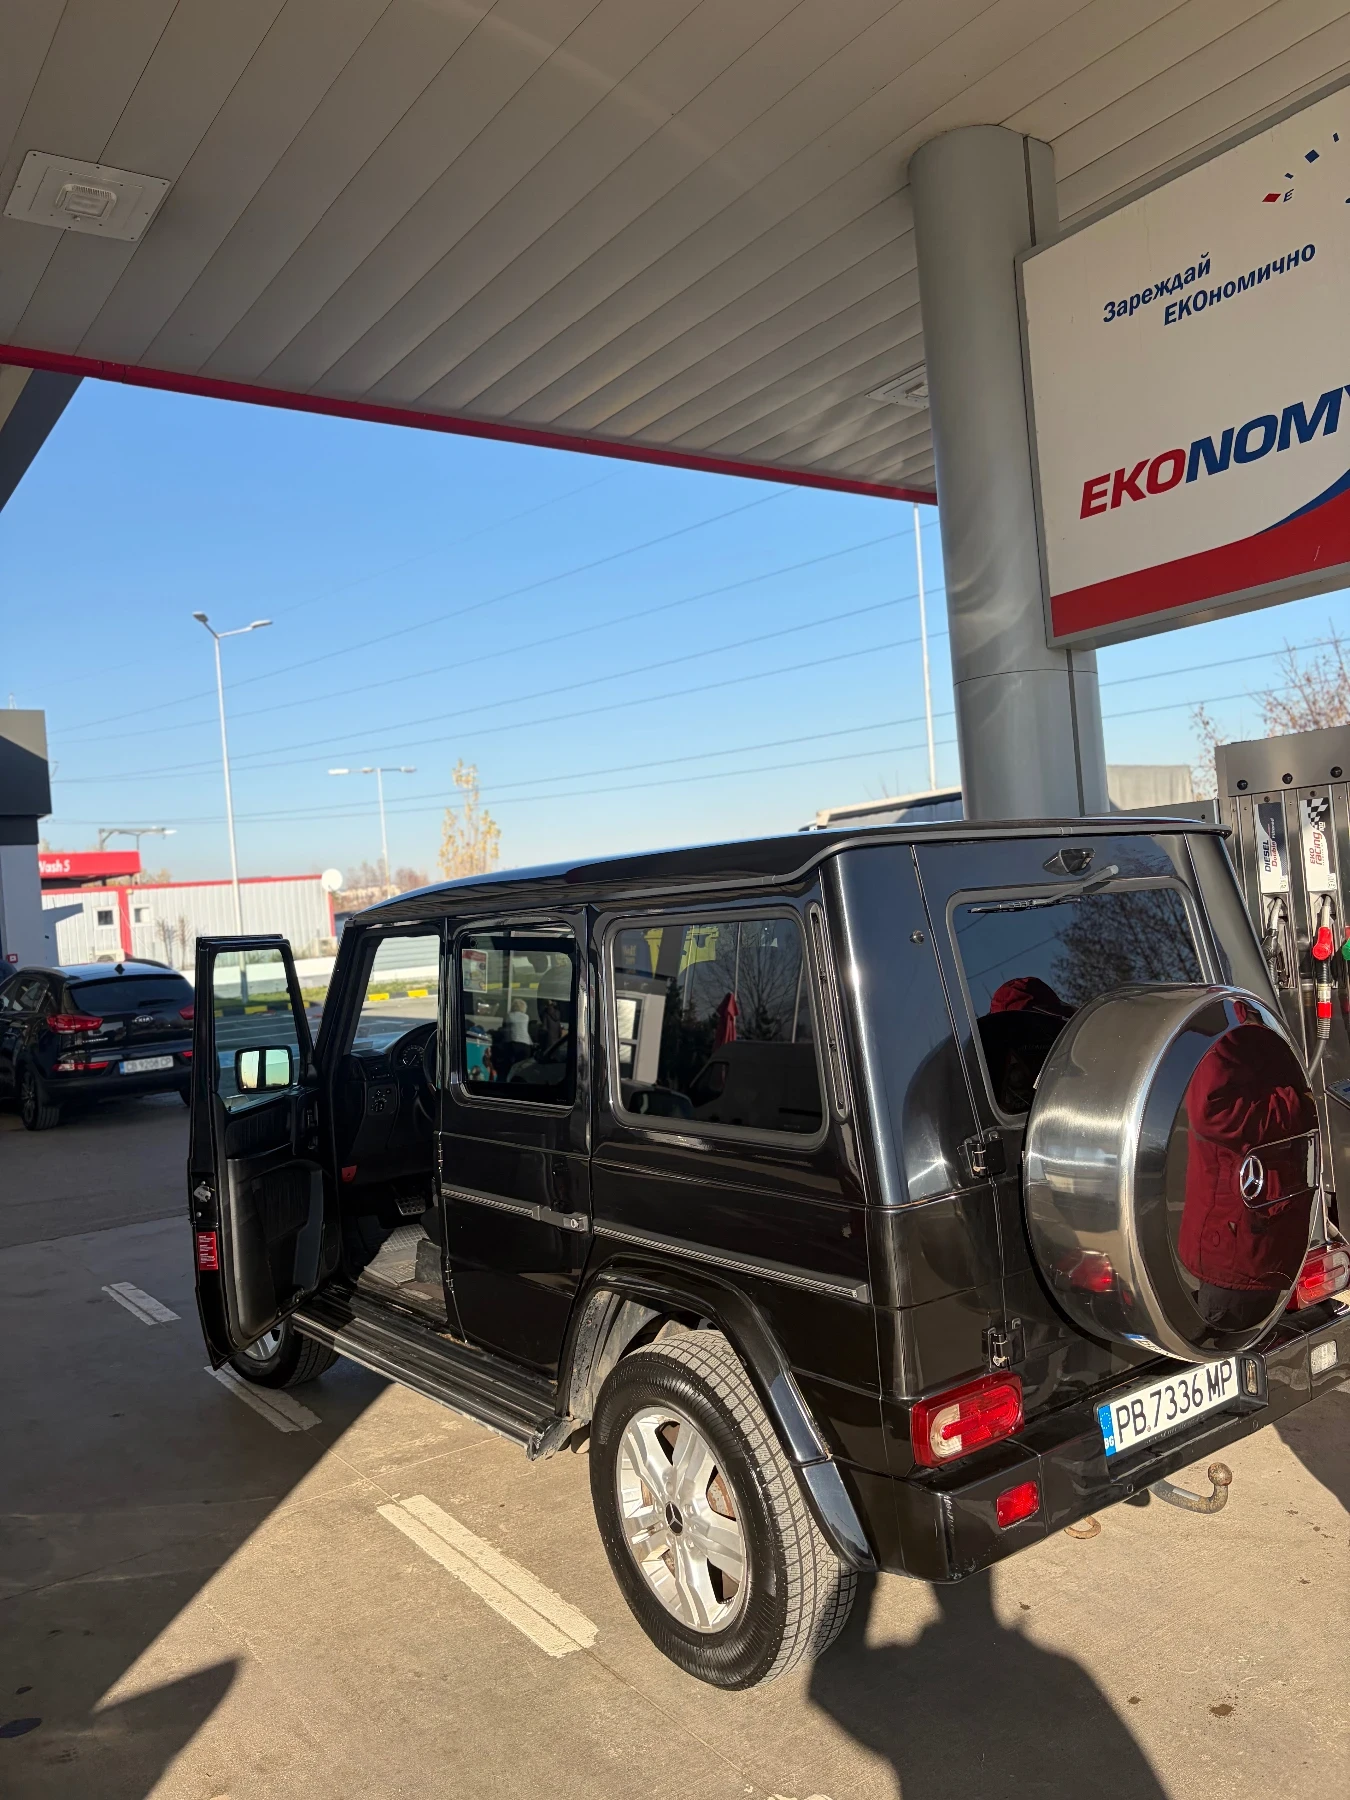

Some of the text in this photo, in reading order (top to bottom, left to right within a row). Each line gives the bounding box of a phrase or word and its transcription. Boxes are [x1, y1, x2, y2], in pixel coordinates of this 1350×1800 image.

[1283, 188, 1294, 203] E
[1103, 252, 1211, 323] Зареждай
[1164, 244, 1316, 326] ЕКОномично
[1080, 384, 1350, 520] EKONOM
[1263, 840, 1271, 872] DIESEL
[1313, 831, 1323, 866] racing
[1149, 1374, 1204, 1428] 7336
[1206, 1360, 1232, 1402] MP
[1104, 1436, 1115, 1450] BG
